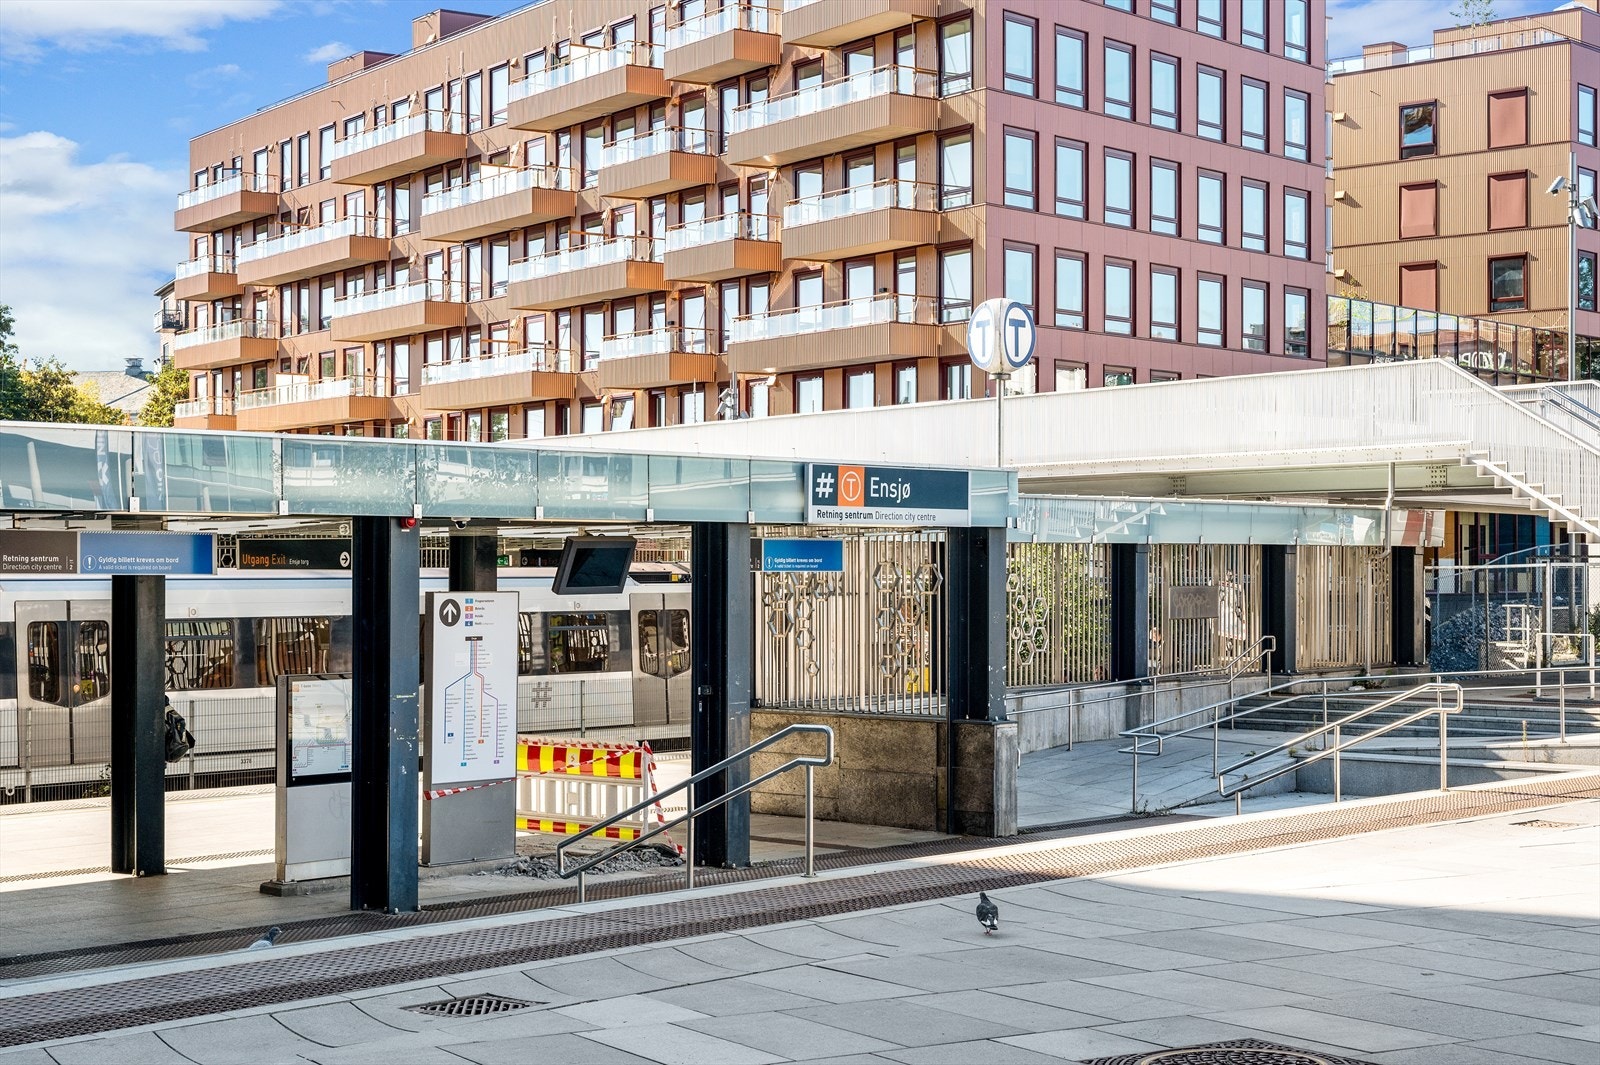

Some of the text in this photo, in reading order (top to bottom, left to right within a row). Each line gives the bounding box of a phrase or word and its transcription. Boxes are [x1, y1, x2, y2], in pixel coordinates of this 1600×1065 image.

[1008, 318, 1026, 357] T
[870, 476, 911, 503] Ensjø
[816, 509, 937, 522] Retning sentrum Direction city centre
[2, 554, 29, 563] Retning
[98, 556, 117, 564] Gyldig
[242, 554, 270, 566] Utgang
[272, 553, 286, 565] Exit
[31, 563, 42, 571] city
